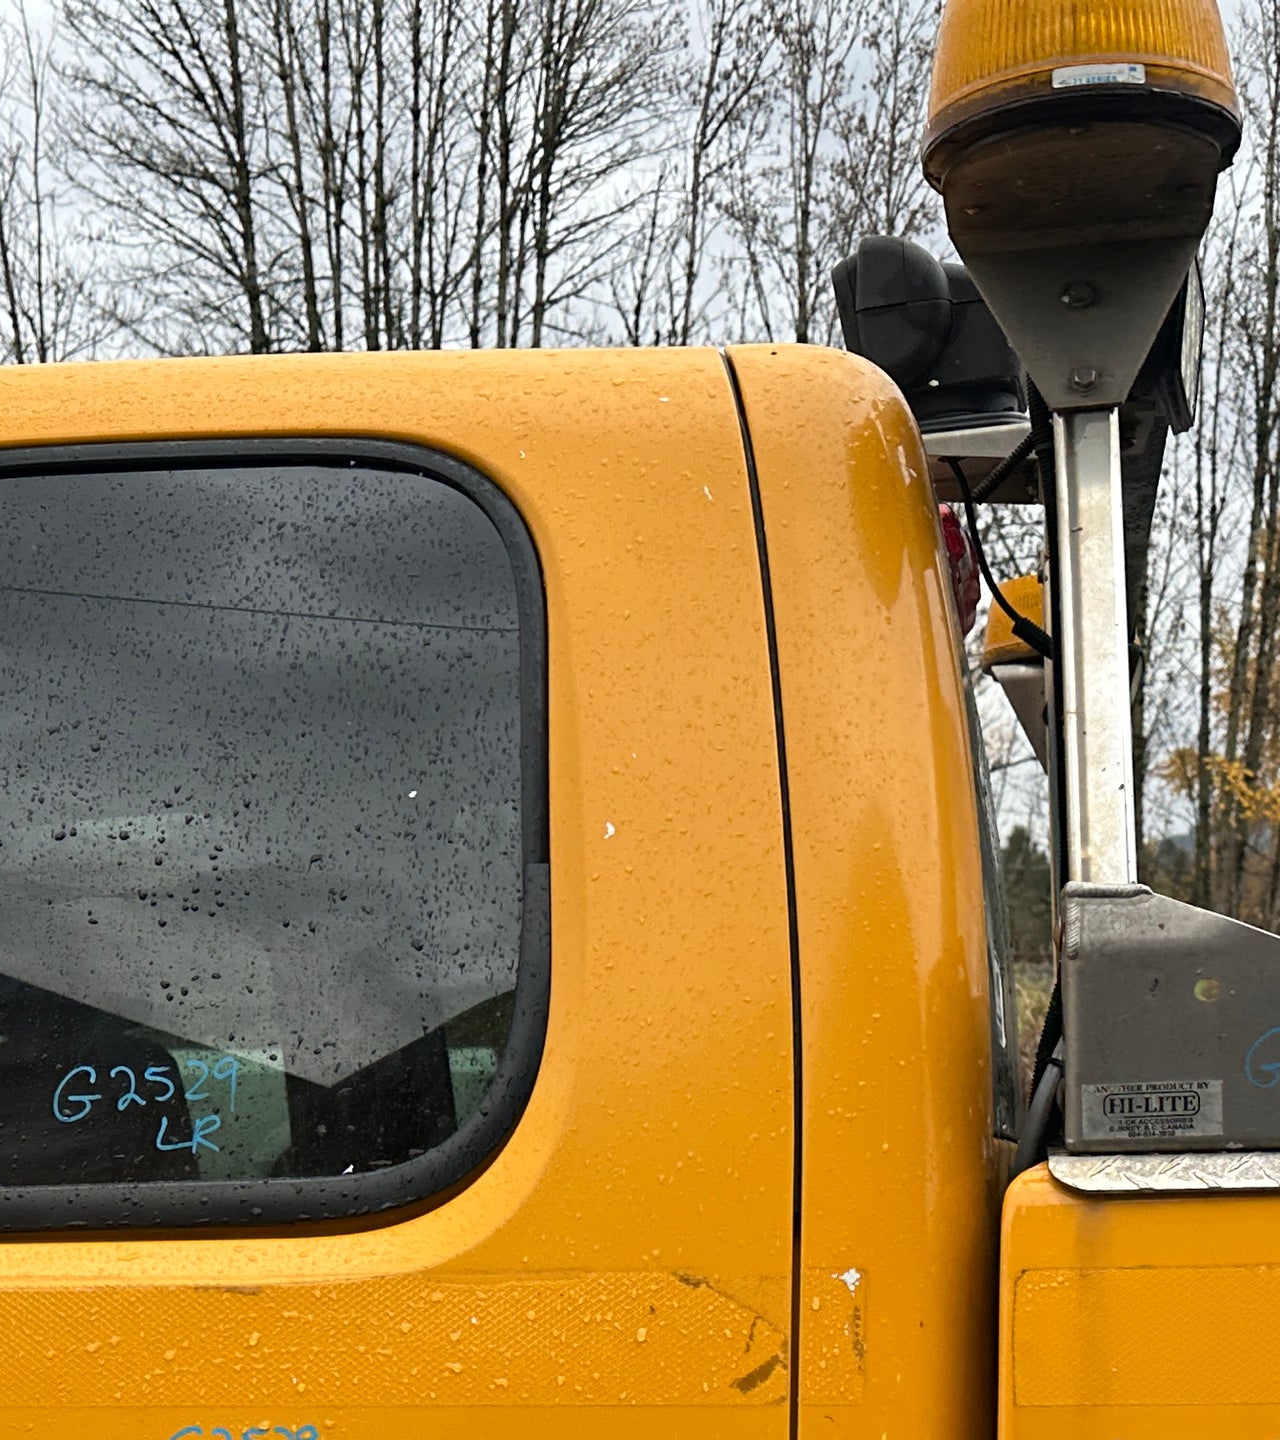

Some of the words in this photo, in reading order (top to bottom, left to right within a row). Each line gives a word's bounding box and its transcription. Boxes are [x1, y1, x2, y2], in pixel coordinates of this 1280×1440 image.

[53, 1057, 239, 1122] G2529
[1196, 1081, 1210, 1089] BY
[1109, 1095, 1196, 1114] HI-LITE
[157, 1115, 219, 1153] LR
